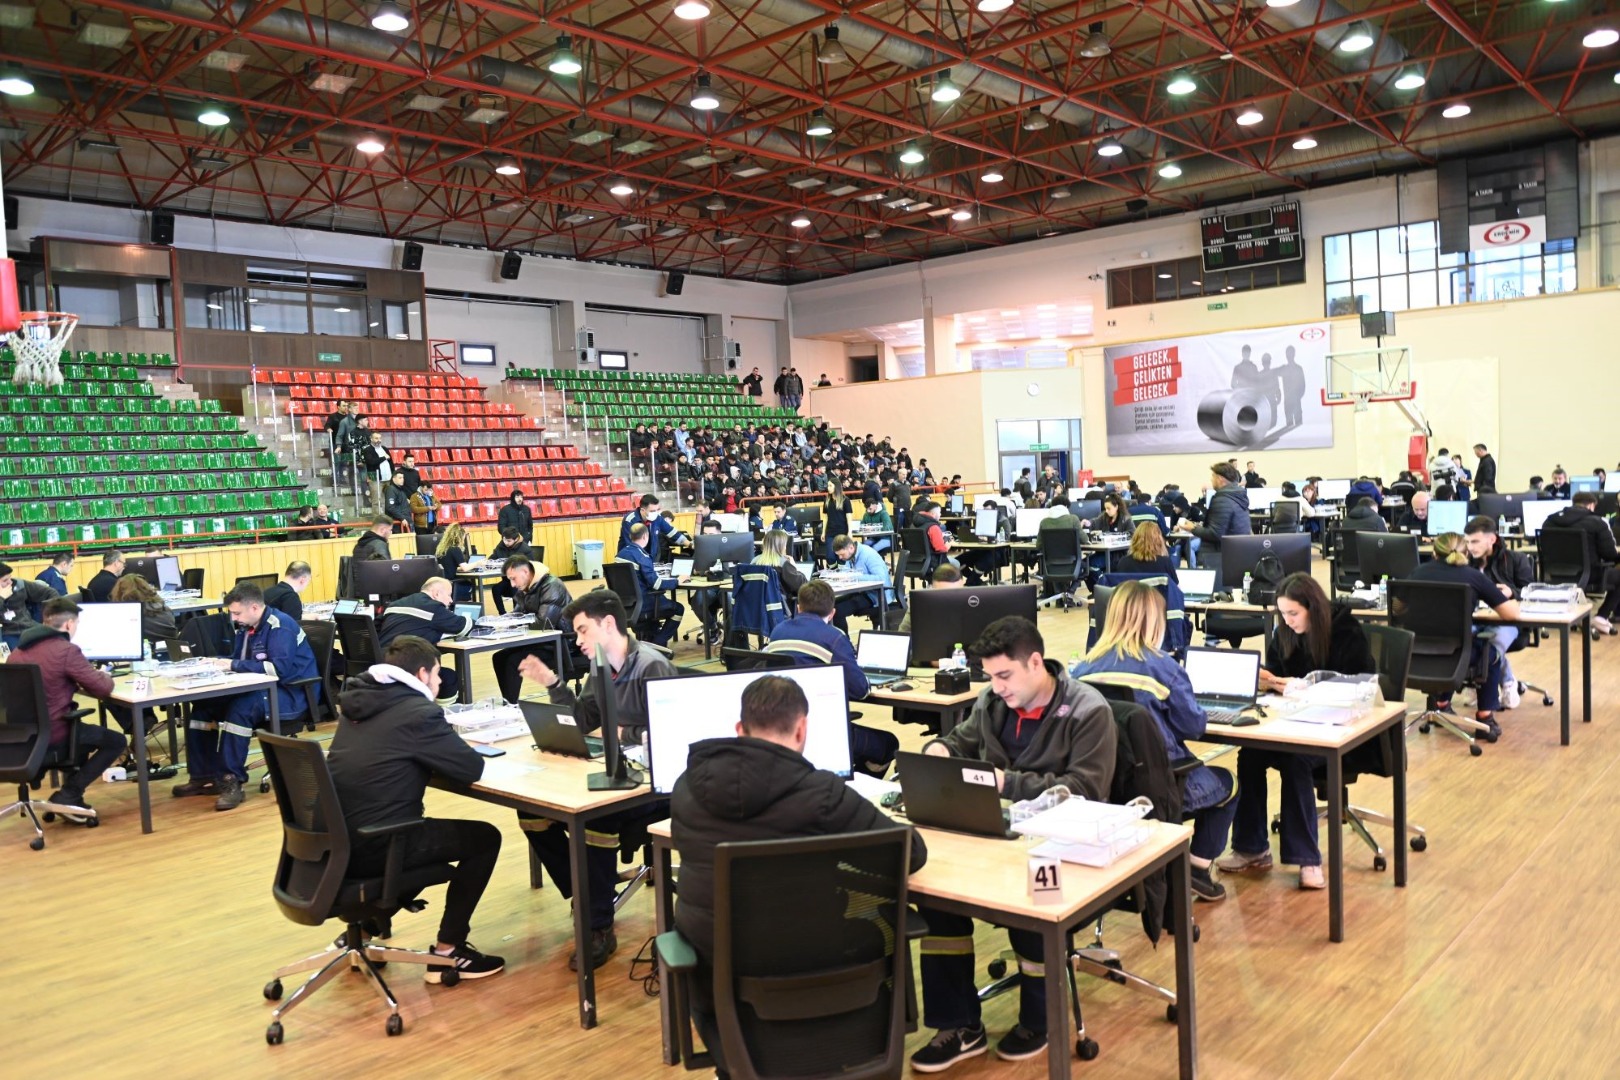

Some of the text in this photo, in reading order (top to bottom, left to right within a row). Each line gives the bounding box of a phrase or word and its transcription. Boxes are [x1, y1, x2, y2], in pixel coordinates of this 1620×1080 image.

[1273, 203, 1296, 213] VISITOR
[1202, 216, 1222, 225] HOME
[1134, 364, 1172, 387] ÇELİKTEN
[1134, 382, 1168, 402] GELECEK
[136, 680, 146, 690] 25
[974, 774, 984, 782] 41
[1035, 864, 1058, 887] 41
